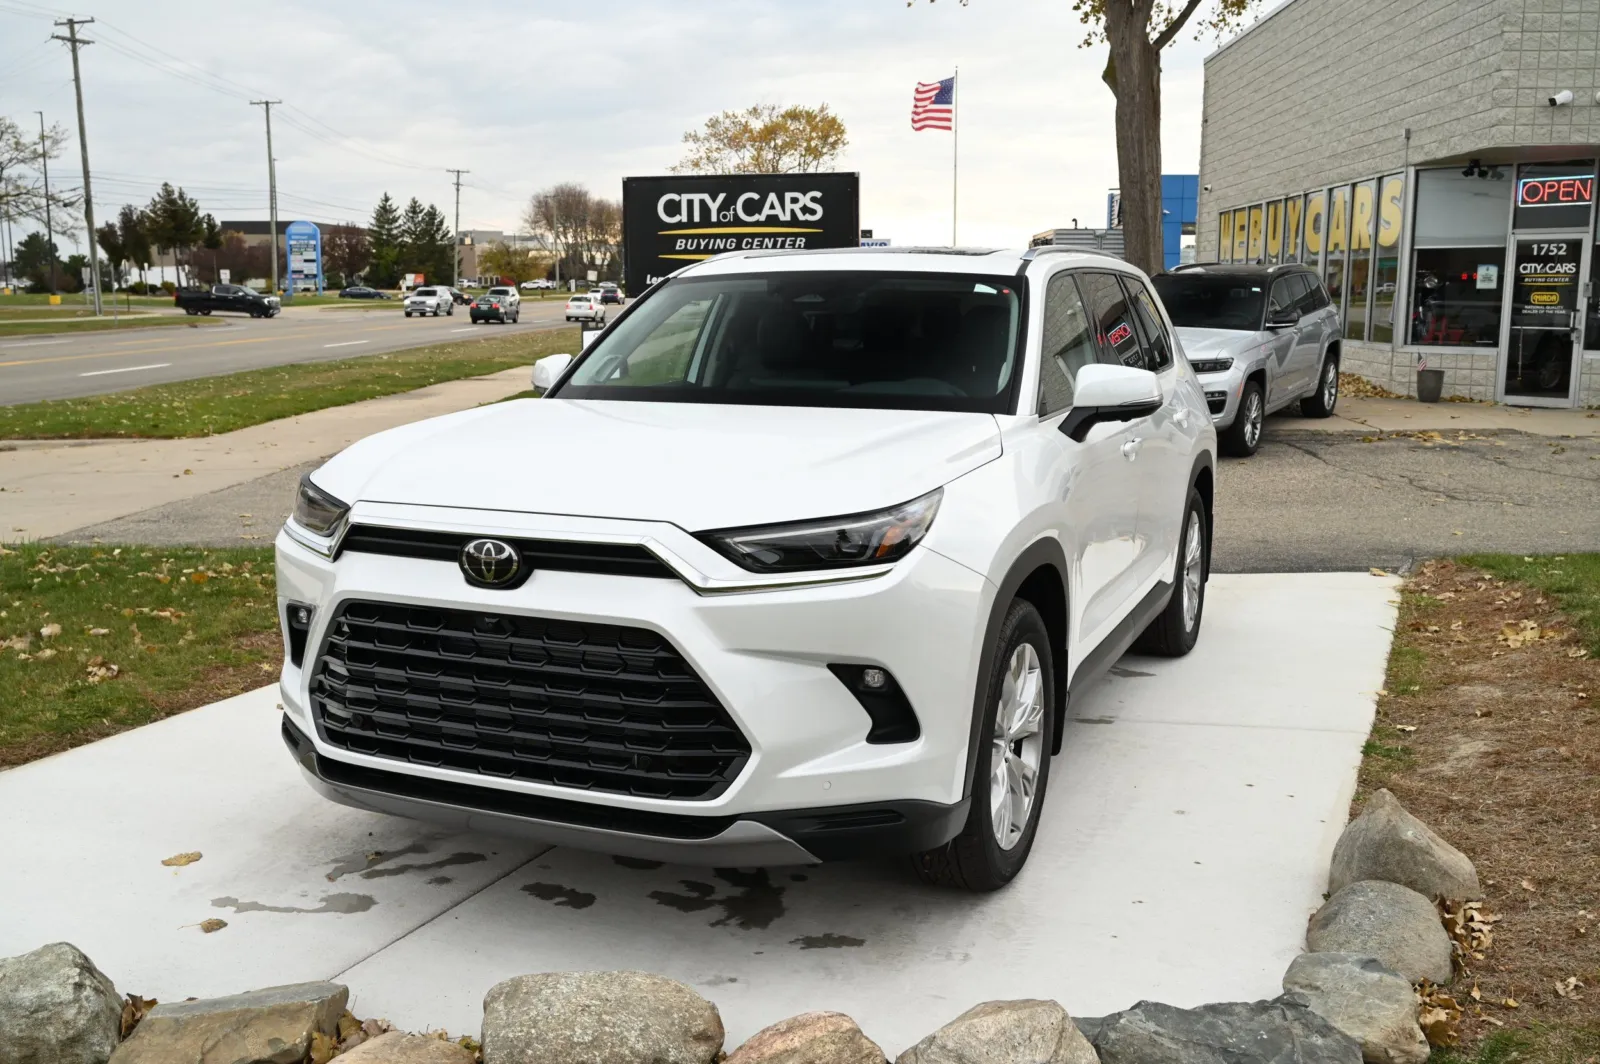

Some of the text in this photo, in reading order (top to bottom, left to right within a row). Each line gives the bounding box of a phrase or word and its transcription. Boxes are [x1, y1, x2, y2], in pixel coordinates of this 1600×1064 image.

[1522, 180, 1592, 202] OPEN
[657, 190, 824, 224] CITY of CARS
[1250, 200, 1301, 259] BUY
[1305, 178, 1404, 254] CARS
[675, 237, 806, 251] BUYING CENTER
[1531, 243, 1568, 256] 1752
[1519, 263, 1544, 274] CITY
[1545, 262, 1577, 274] CARS
